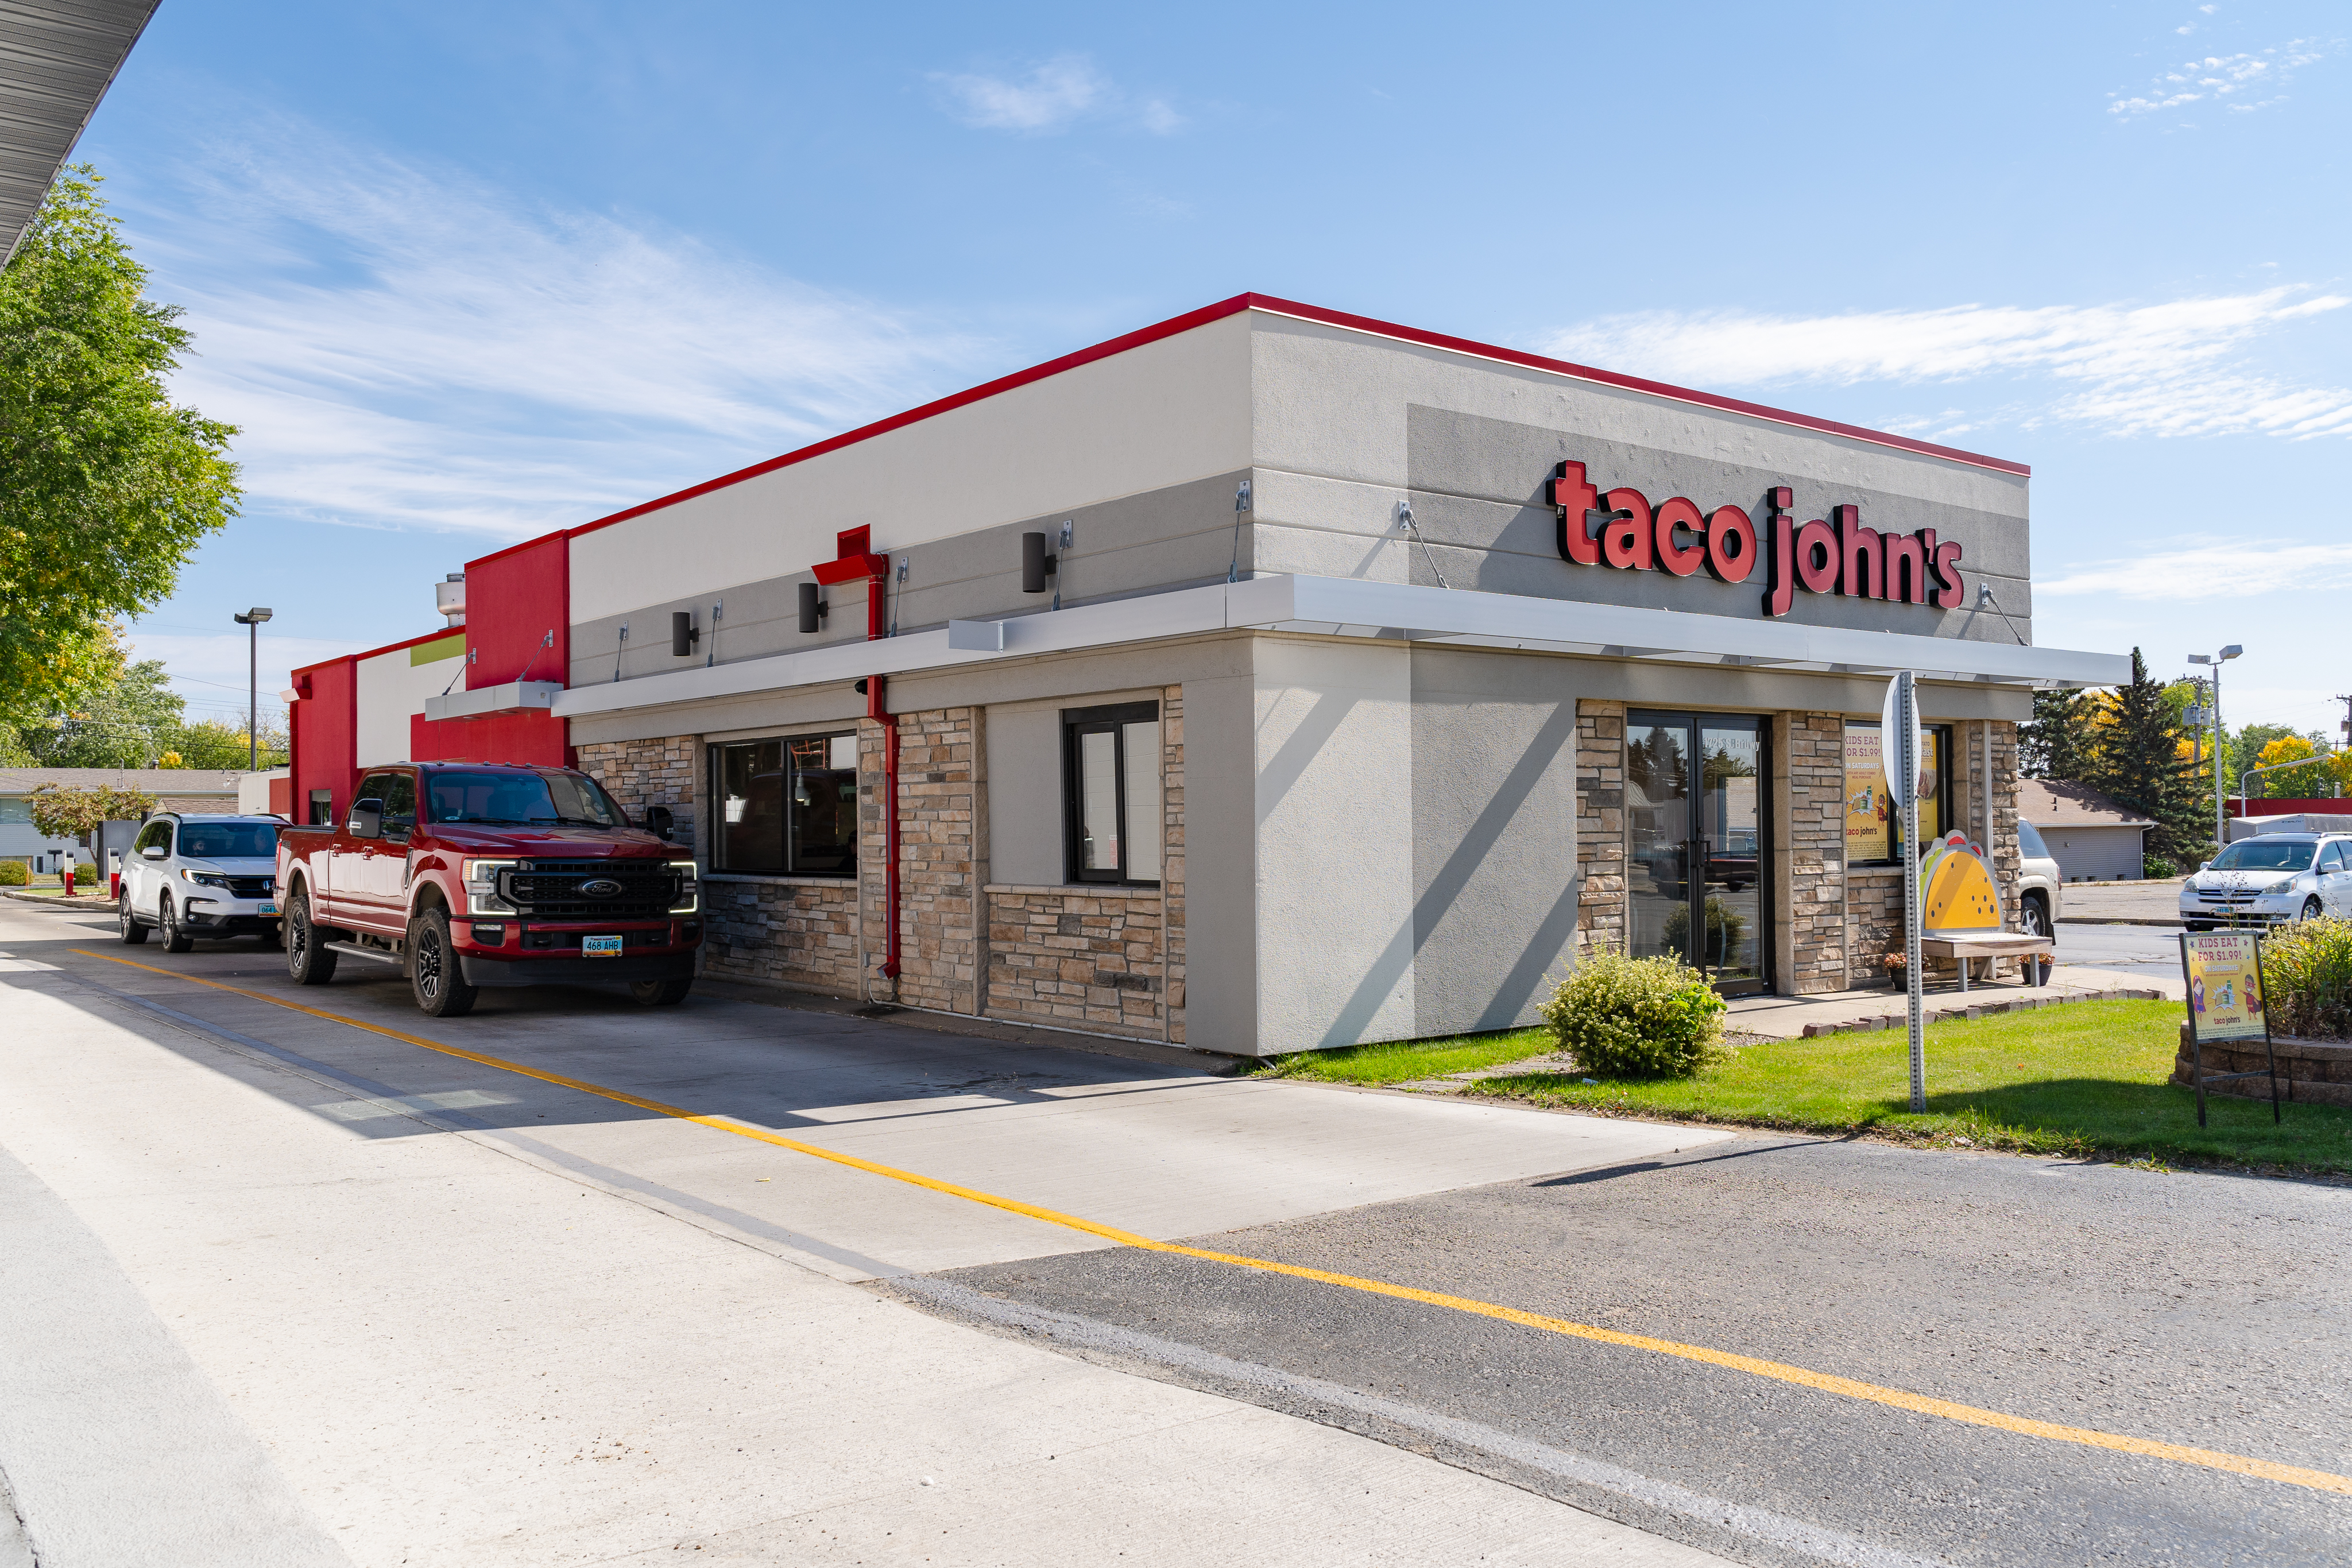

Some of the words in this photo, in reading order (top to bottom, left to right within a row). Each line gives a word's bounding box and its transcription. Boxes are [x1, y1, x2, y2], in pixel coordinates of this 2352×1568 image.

[1546, 460, 1757, 583] taco
[1762, 486, 1964, 617] john's
[1704, 737, 1723, 748] 1725
[1726, 738, 1734, 749] S.
[1735, 738, 1760, 751] Brdwy
[1864, 736, 1879, 745] EAT
[1845, 748, 1858, 757] OR
[1859, 747, 1881, 757] $1.99!
[1860, 826, 1877, 838] john's
[591, 884, 613, 893] Ford
[587, 941, 601, 950] 468
[604, 941, 618, 950] AHB
[2198, 938, 2218, 948] KIDS
[2221, 937, 2238, 947] EAT
[2198, 951, 2215, 961] FOR
[2216, 950, 2242, 962] $1.99!
[2212, 965, 2238, 973] SATURDAYS
[2226, 1016, 2241, 1025] john's
